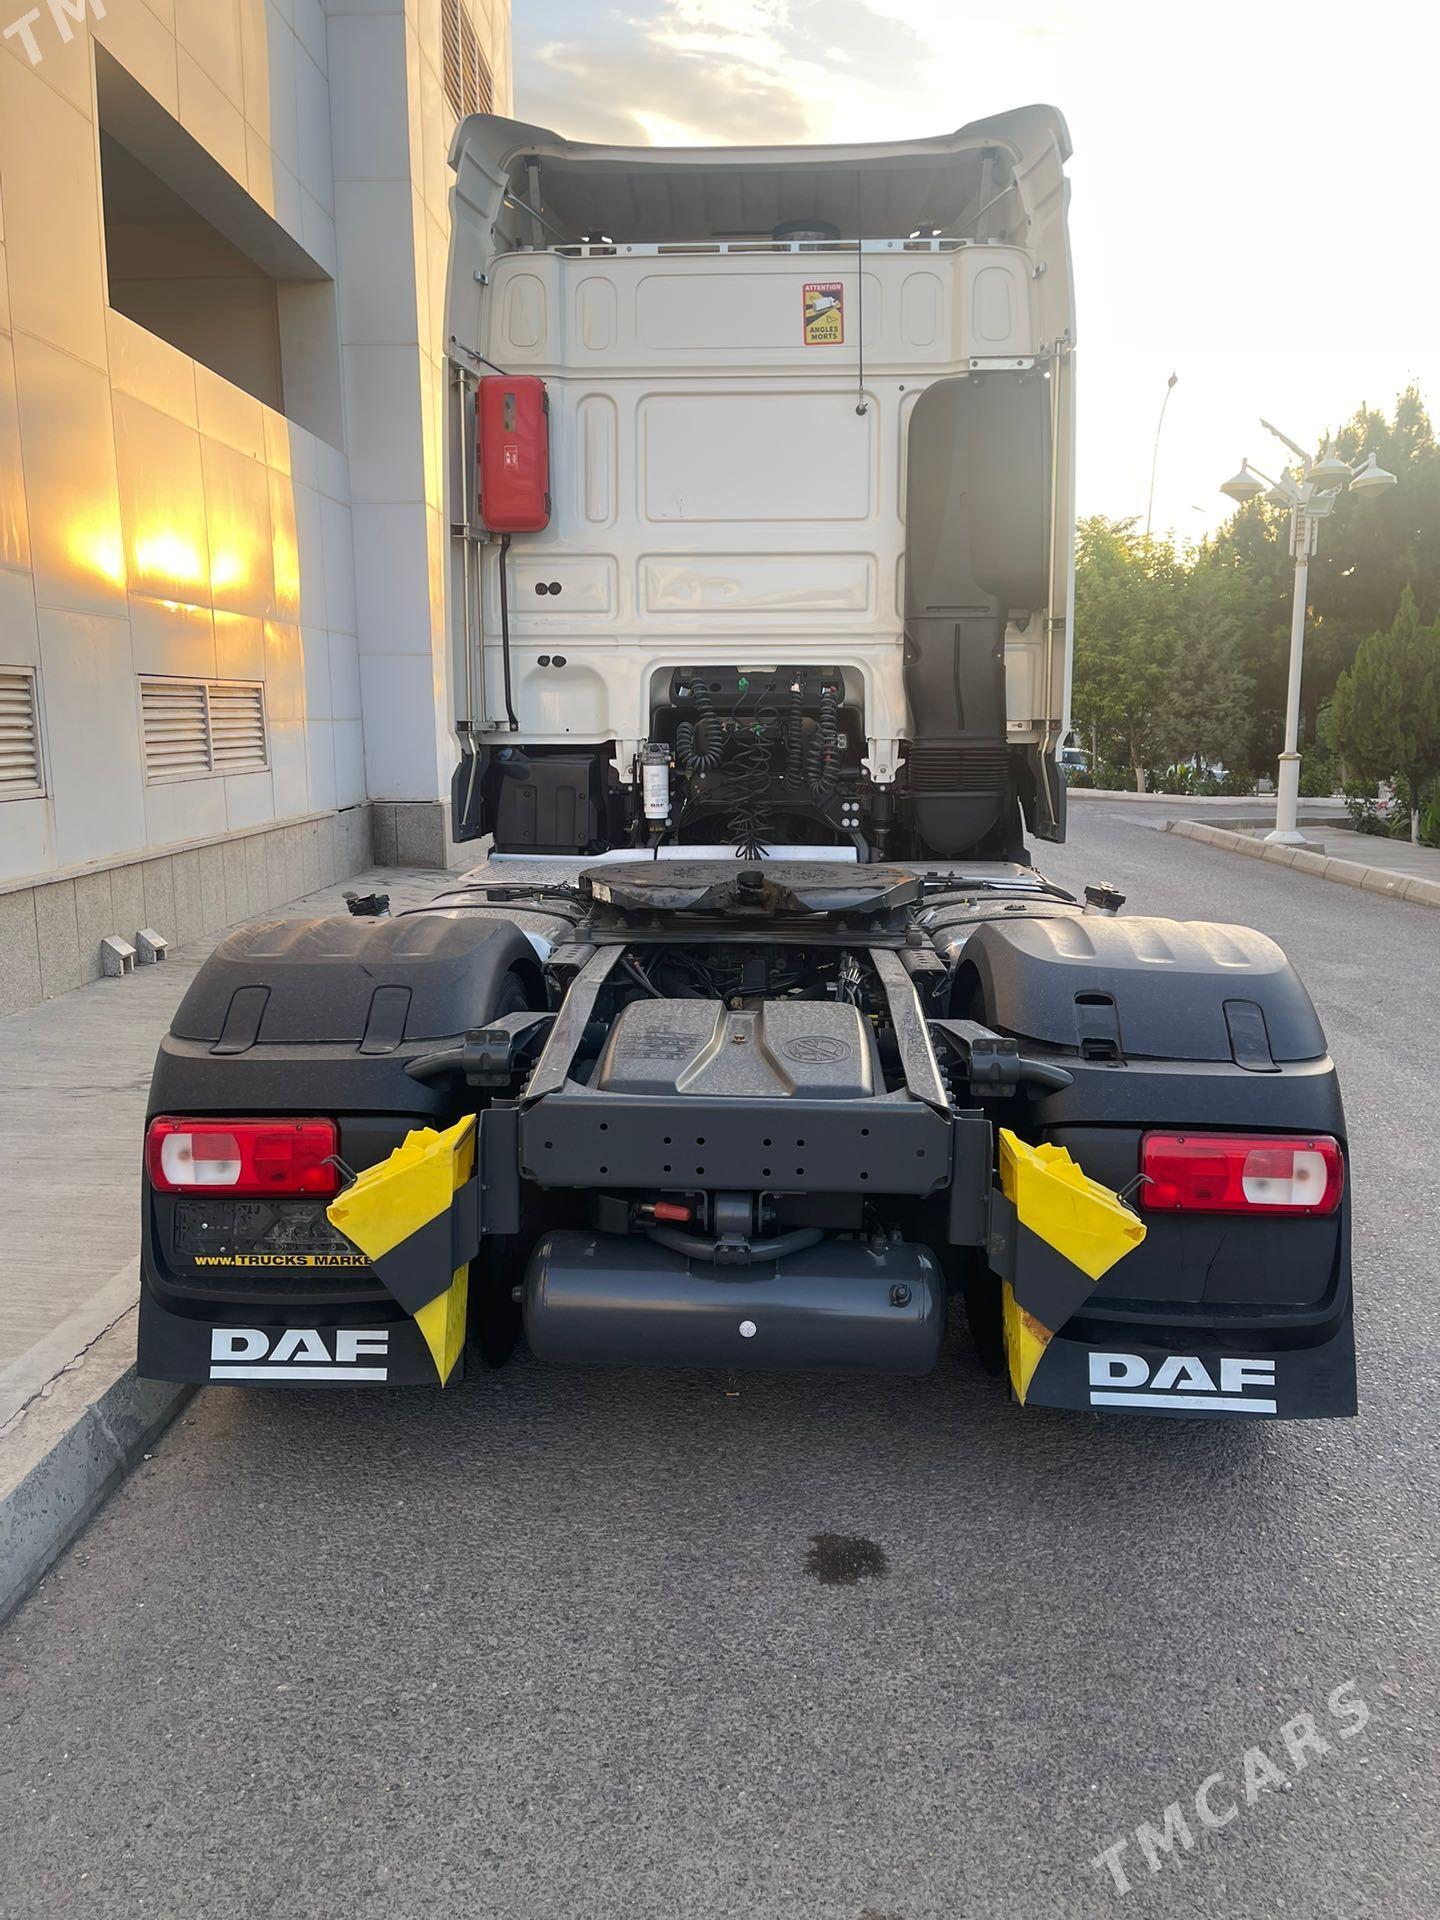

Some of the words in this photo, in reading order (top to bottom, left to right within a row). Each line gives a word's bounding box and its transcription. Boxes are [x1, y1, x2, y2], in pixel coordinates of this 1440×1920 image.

[805, 283, 841, 291] ATTENTION
[811, 332, 837, 340] MORTS
[211, 1328, 389, 1362] DAF
[1088, 1352, 1276, 1392] DAF
